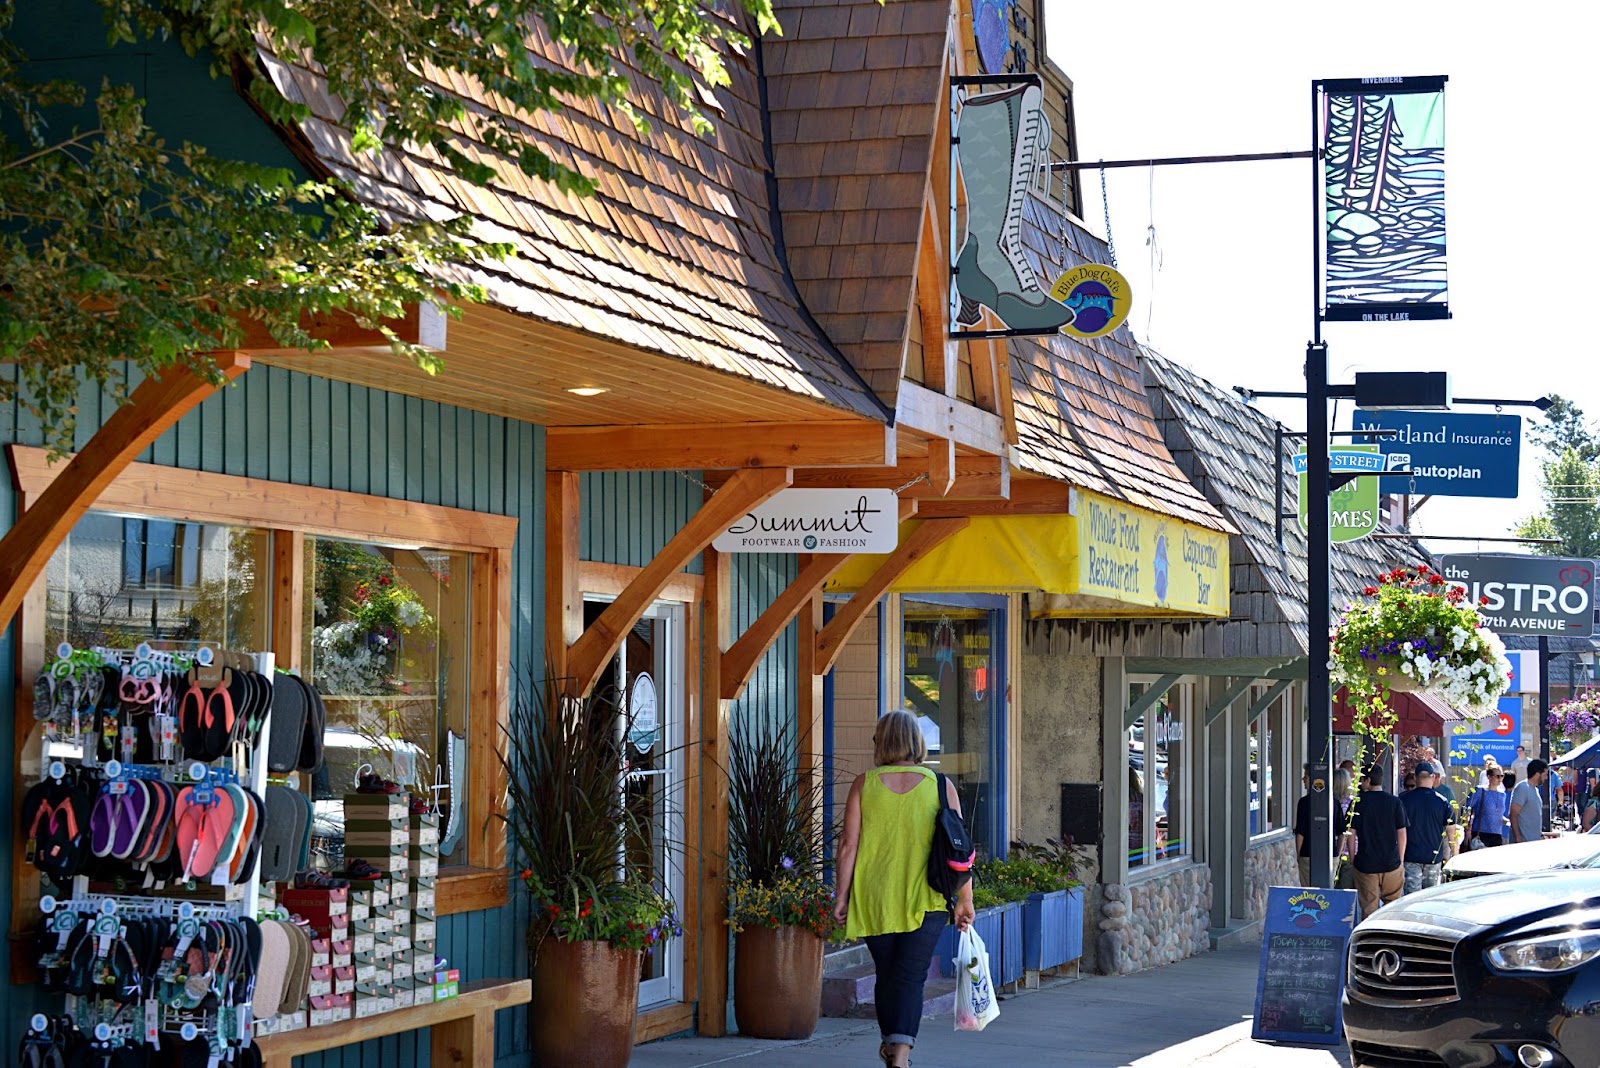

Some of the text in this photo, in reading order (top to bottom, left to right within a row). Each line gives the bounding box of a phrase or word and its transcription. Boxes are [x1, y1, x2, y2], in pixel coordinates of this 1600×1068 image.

[1058, 267, 1120, 296] Blue Dog Café
[1362, 312, 1410, 321] ON THE LAKE
[1361, 423, 1512, 446] Westland Insurance
[1334, 456, 1380, 469] STREET
[1413, 465, 1481, 480] autoplan
[728, 496, 881, 534] Summit
[1089, 501, 1116, 546] Whole
[1119, 512, 1140, 553] Food
[742, 538, 800, 547] FOOTWEAR
[820, 538, 867, 547] FASHION
[1089, 546, 1139, 594] Restaurant
[1445, 565, 1469, 578] the
[1197, 573, 1211, 605] Bar
[1509, 617, 1566, 630] AVENUE
